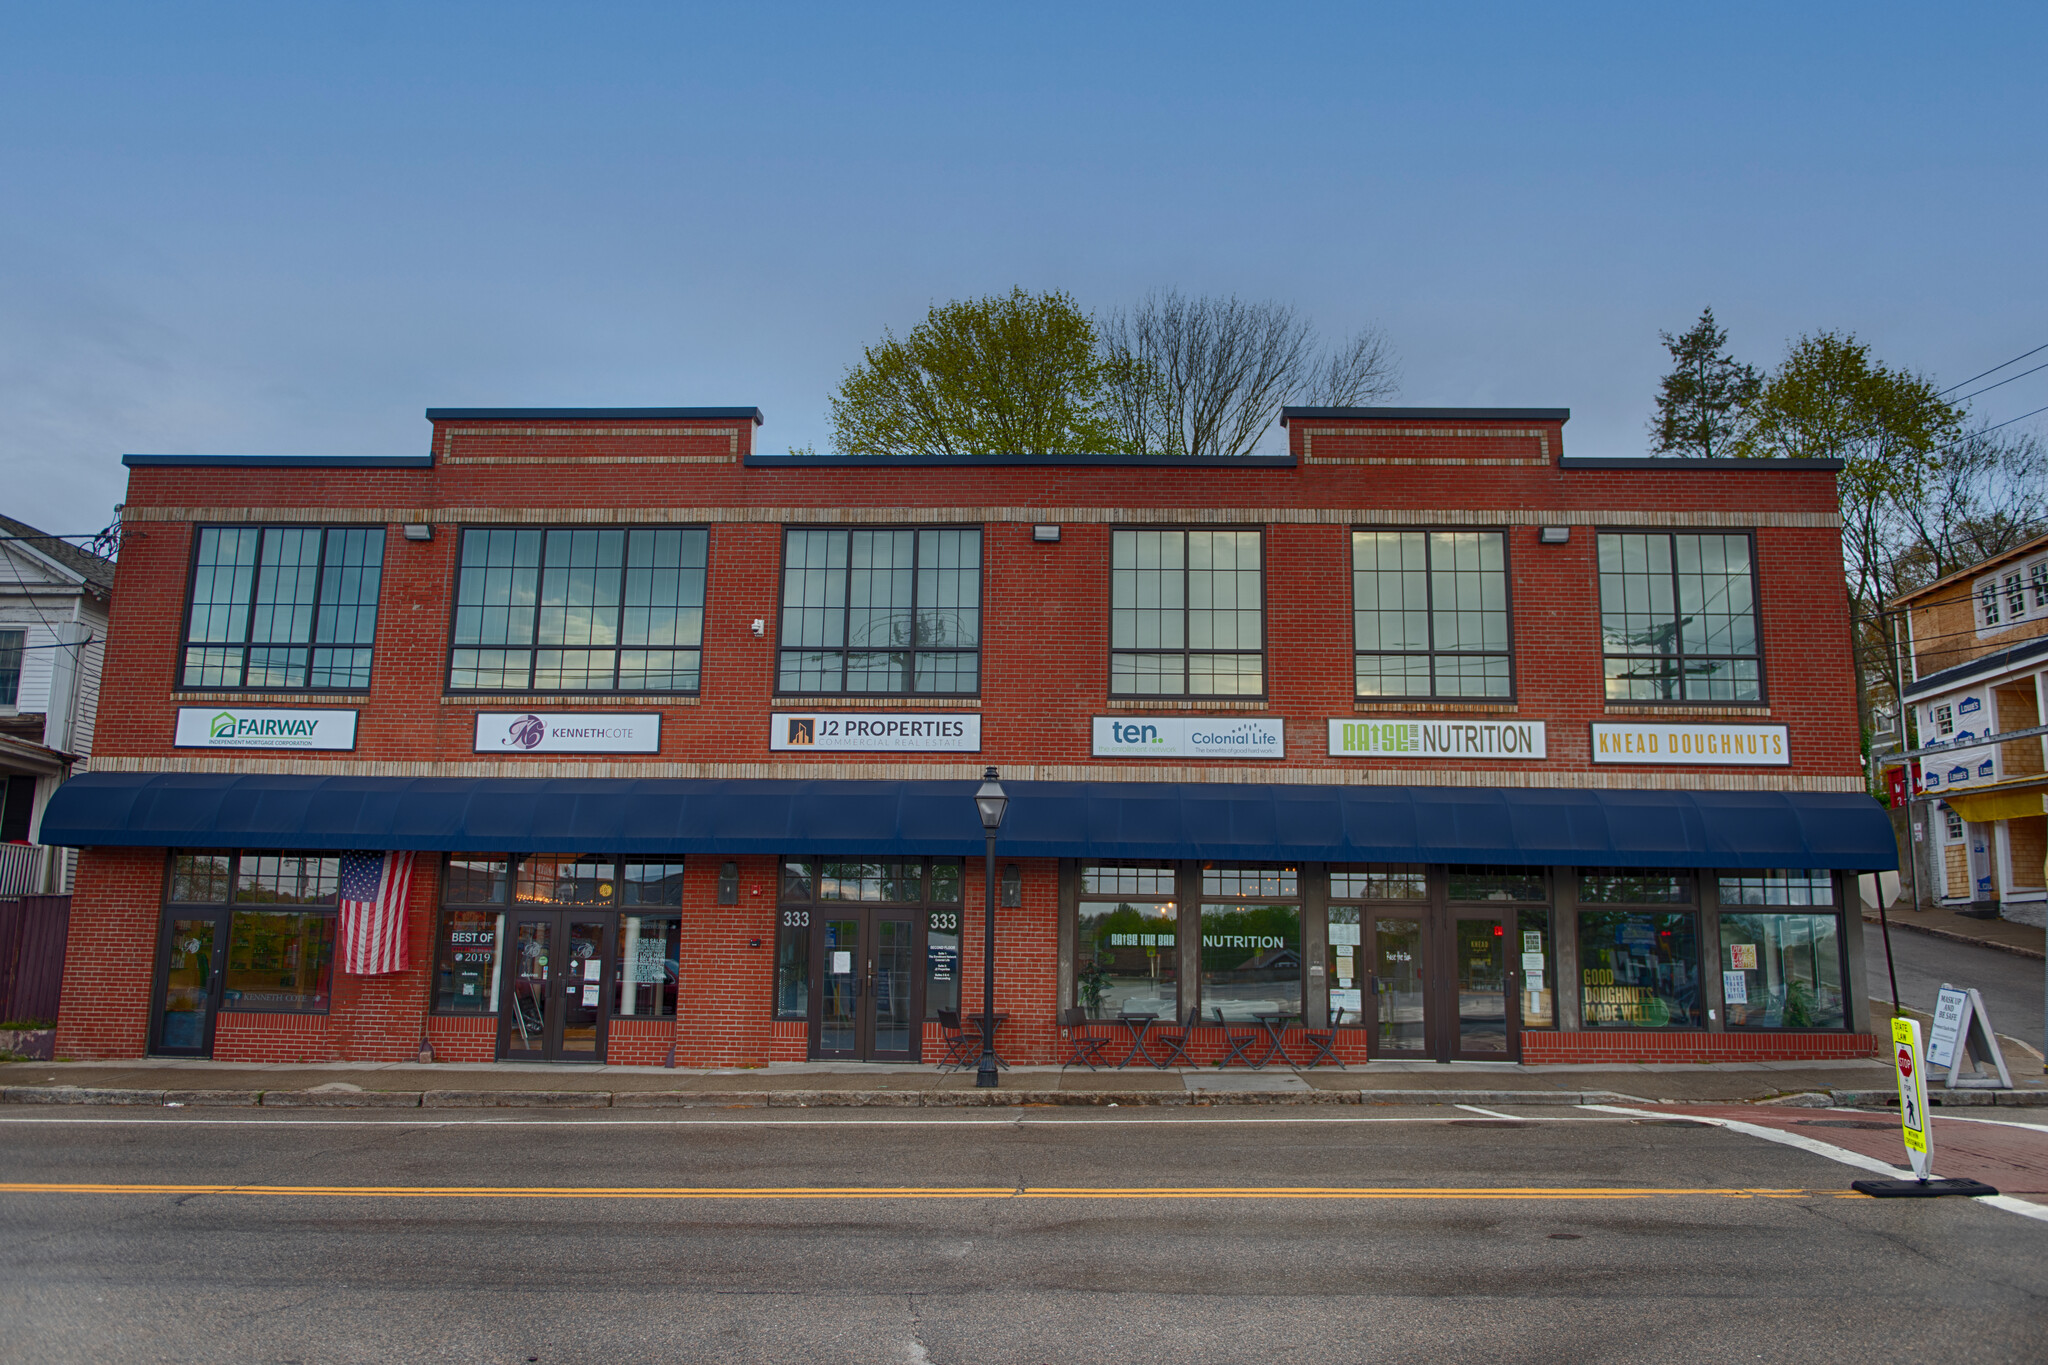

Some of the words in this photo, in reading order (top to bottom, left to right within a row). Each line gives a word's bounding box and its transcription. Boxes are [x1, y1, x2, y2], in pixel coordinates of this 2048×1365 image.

[1960, 701, 1979, 713] LOWE'S
[237, 719, 319, 736] FAIRWAY
[819, 720, 839, 736] J2
[845, 720, 964, 737] PROPERTIES
[818, 738, 890, 746] COMMERCIAL
[894, 738, 921, 746] REAL
[925, 738, 963, 747] ESTATE
[1191, 731, 1249, 745] Colonial
[1423, 724, 1533, 754] NUTRITION
[1599, 732, 1659, 754] KNEAD
[1668, 732, 1782, 755] DOUGHNUTS
[1098, 745, 1110, 753] the
[1111, 745, 1146, 753] enrollment
[1147, 745, 1177, 753] network
[1233, 747, 1248, 755] good
[783, 911, 810, 927] 333
[930, 913, 957, 929] 333
[452, 932, 478, 943] BEST
[480, 932, 494, 943] OF
[1157, 934, 1175, 946] BAR
[1202, 935, 1284, 949] NUTRITION
[465, 953, 491, 962] 2019
[1732, 952, 1754, 961] LIVES
[1583, 968, 1614, 986] GOOD
[1584, 986, 1654, 1003] DOUGHNUTS
[1941, 994, 1955, 1004] MASK
[1954, 998, 1962, 1006] UP
[1585, 1004, 1619, 1022] MADE
[1621, 1004, 1652, 1022] WELL
[1943, 1004, 1955, 1013] AND
[1938, 1010, 1945, 1018] BE
[1945, 1012, 1958, 1021] SAFE
[1893, 1021, 1908, 1033] STATE
[1896, 1031, 1907, 1042] LAW
[1898, 1057, 1911, 1069] STOP
